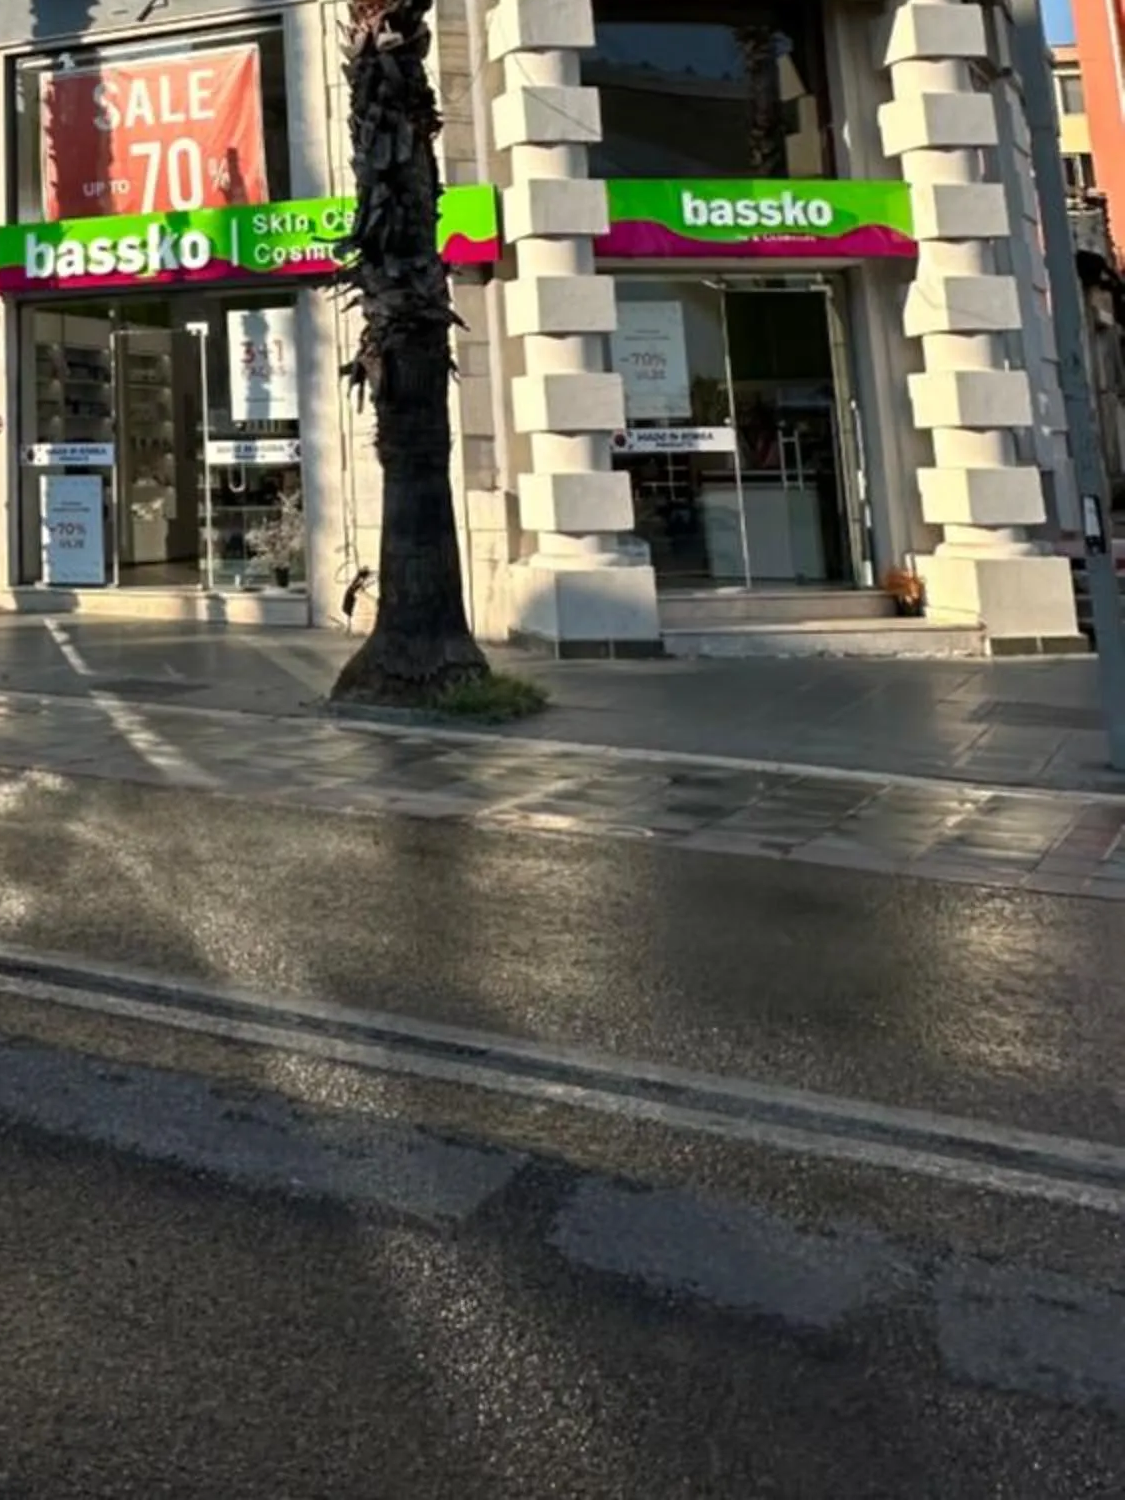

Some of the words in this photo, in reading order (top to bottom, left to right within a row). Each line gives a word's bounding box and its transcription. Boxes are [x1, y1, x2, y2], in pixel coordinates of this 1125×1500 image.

[92, 69, 215, 130] SALE
[82, 182, 106, 196] UP
[110, 179, 131, 194] TO
[252, 212, 309, 235] Skin
[681, 189, 833, 227] bassko
[26, 222, 212, 278] bassko
